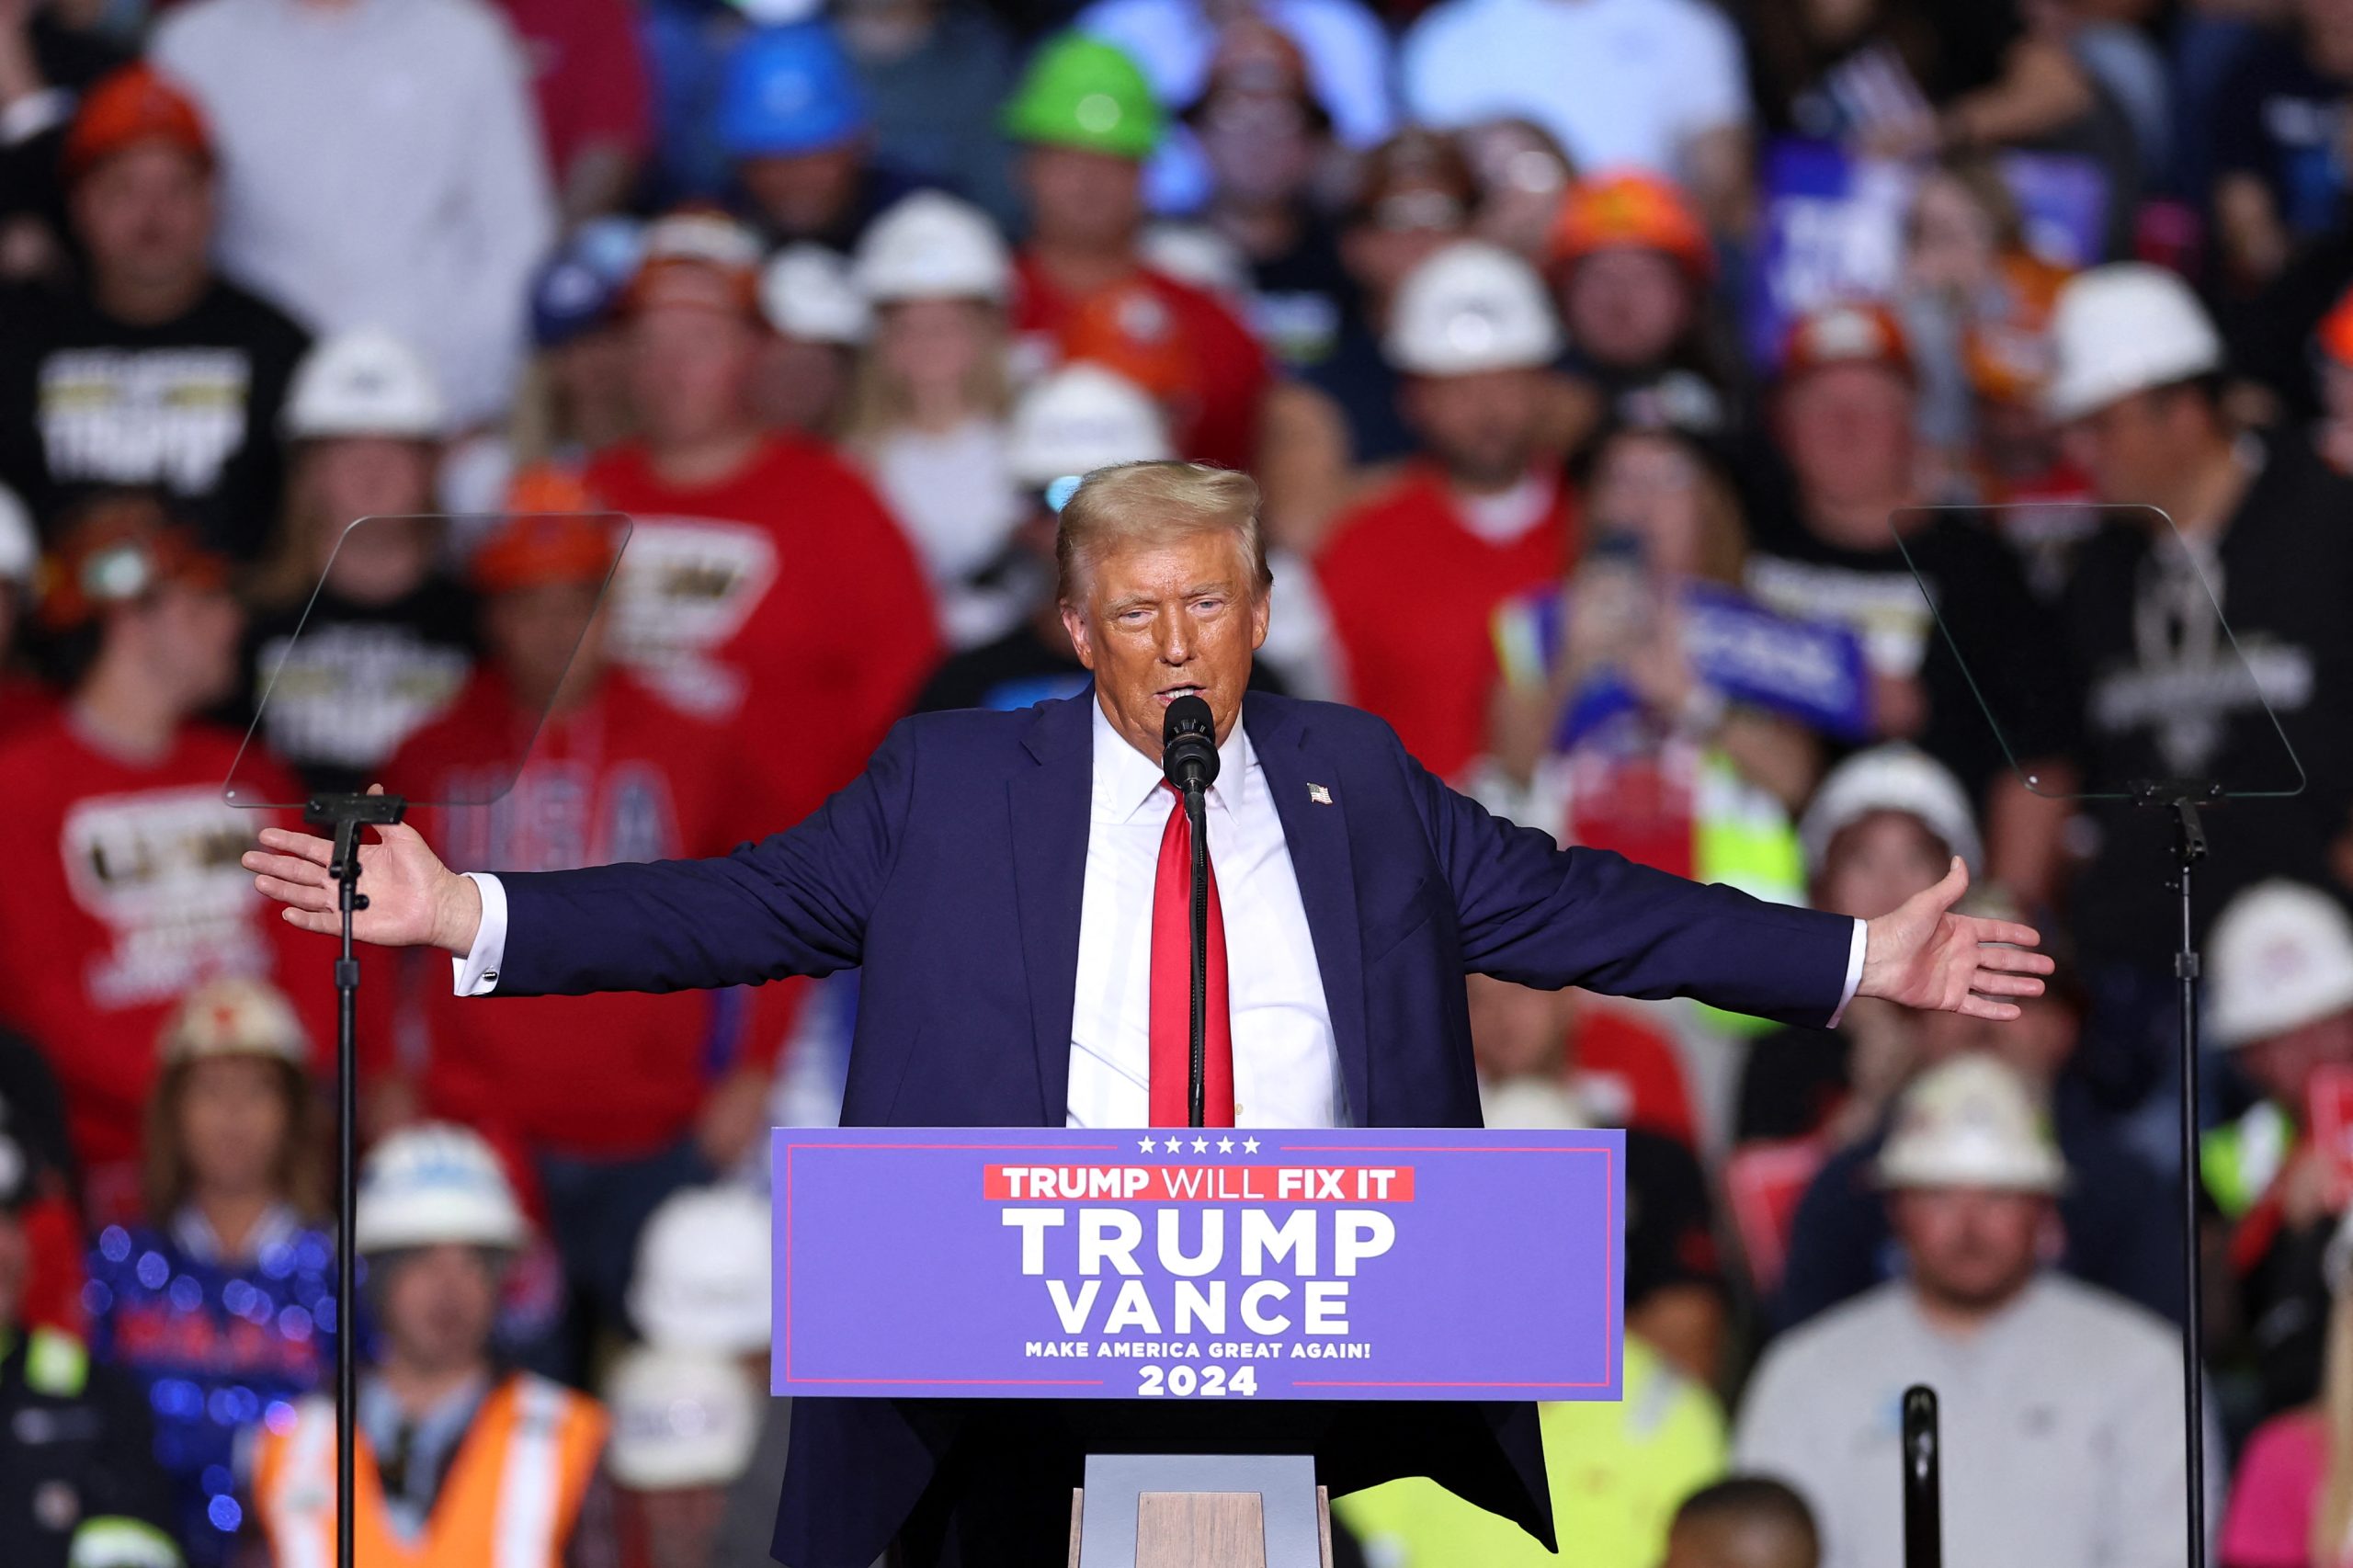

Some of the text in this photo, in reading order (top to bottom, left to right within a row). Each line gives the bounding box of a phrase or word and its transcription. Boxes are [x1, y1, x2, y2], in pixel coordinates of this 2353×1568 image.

[1002, 1167, 1396, 1199] TRUMP WILL FIX IT
[1002, 1208, 1395, 1277] TRUMP
[1045, 1279, 1349, 1335] VANCE
[1025, 1341, 1370, 1358] MAKE AMERICA GREAT AGAIN!
[1138, 1365, 1258, 1397] 2024
